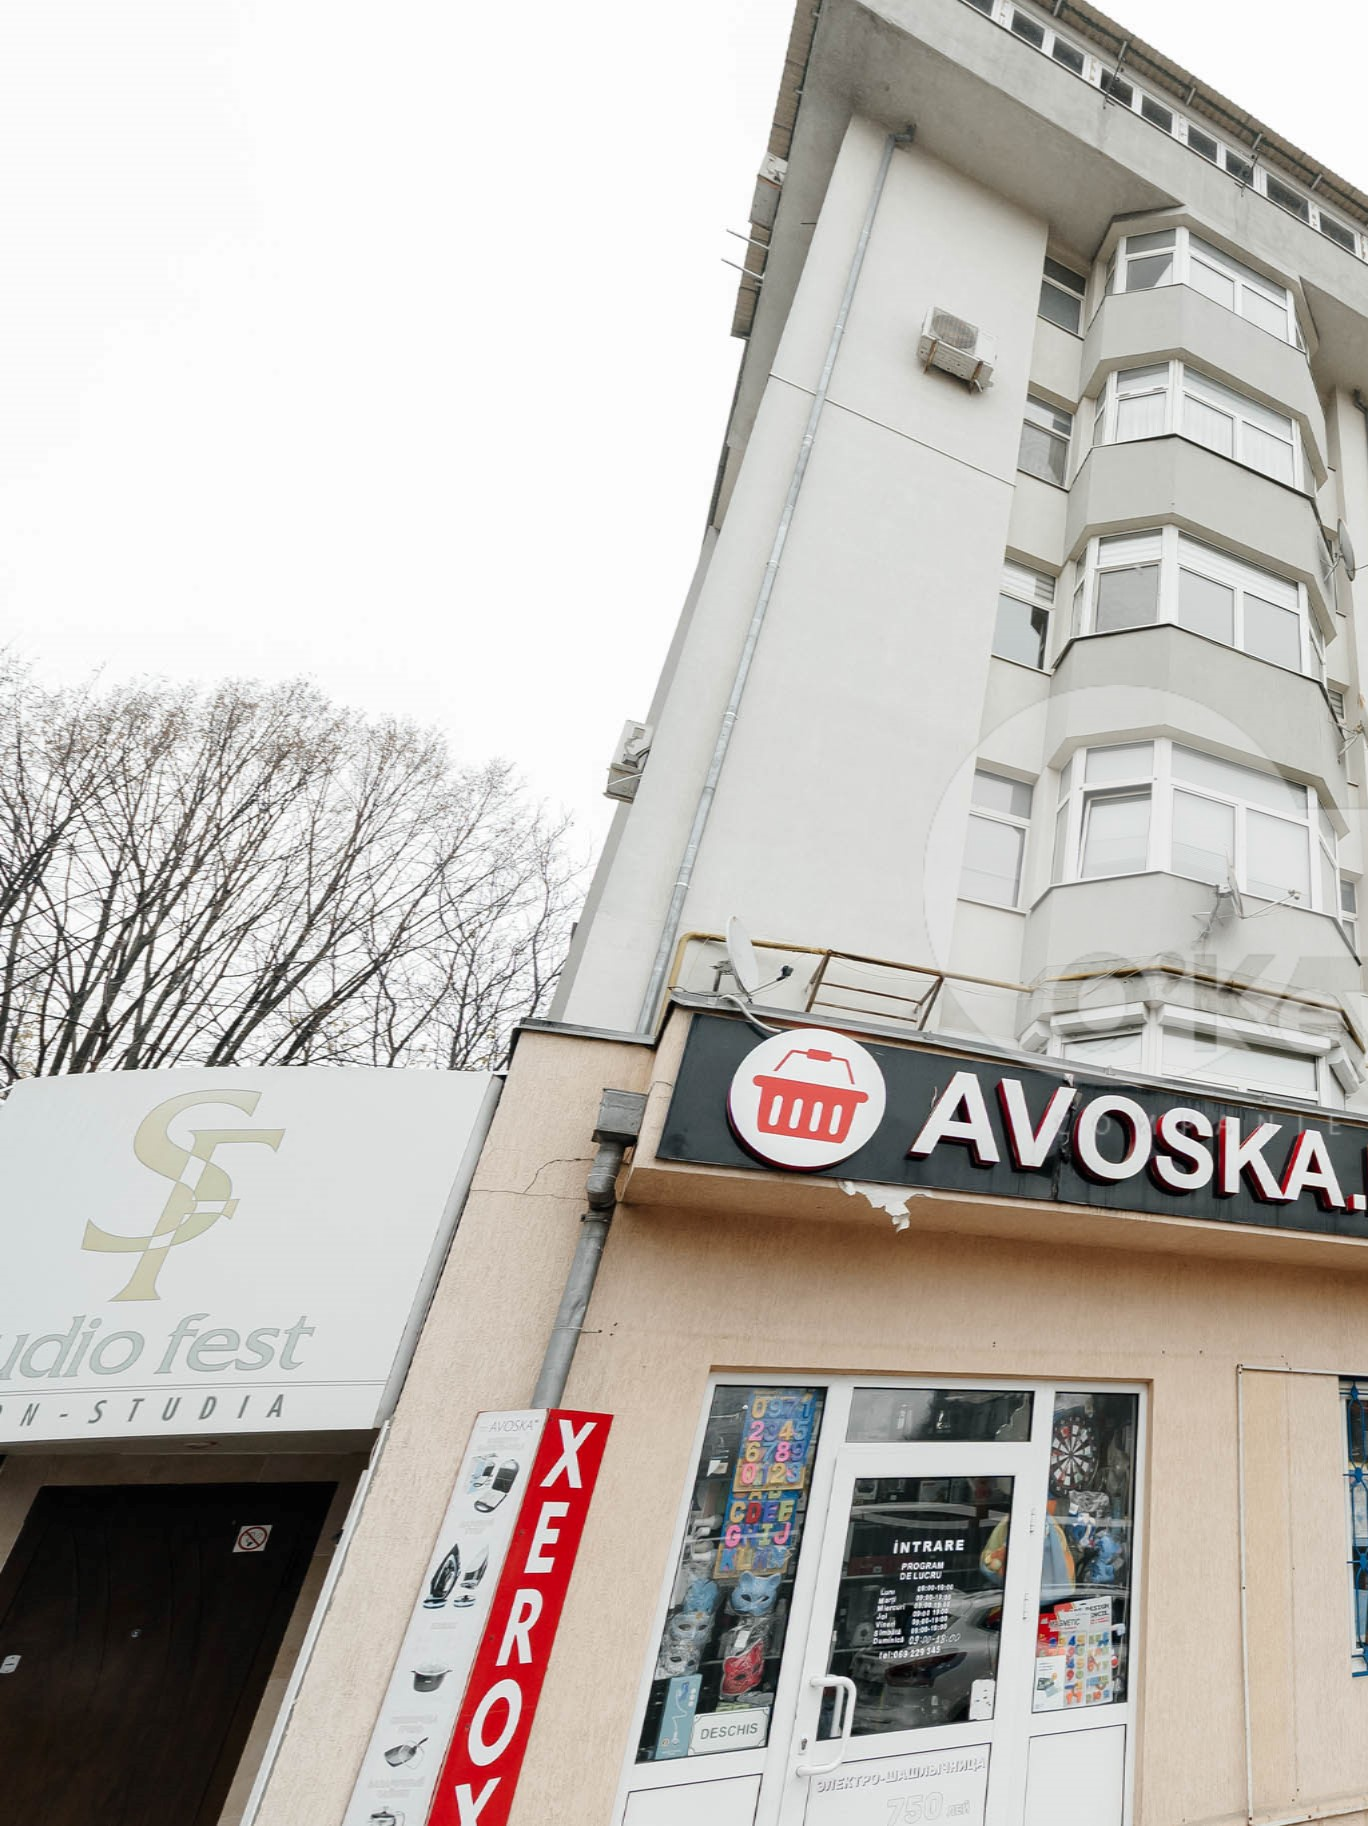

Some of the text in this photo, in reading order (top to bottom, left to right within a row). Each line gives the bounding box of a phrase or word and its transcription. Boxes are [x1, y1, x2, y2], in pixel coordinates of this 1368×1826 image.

[154, 1313, 316, 1374] fest
[901, 1562, 944, 1570] PROGRAM
[700, 1723, 758, 1739] DESCHIS
[886, 1791, 944, 1826] 750
